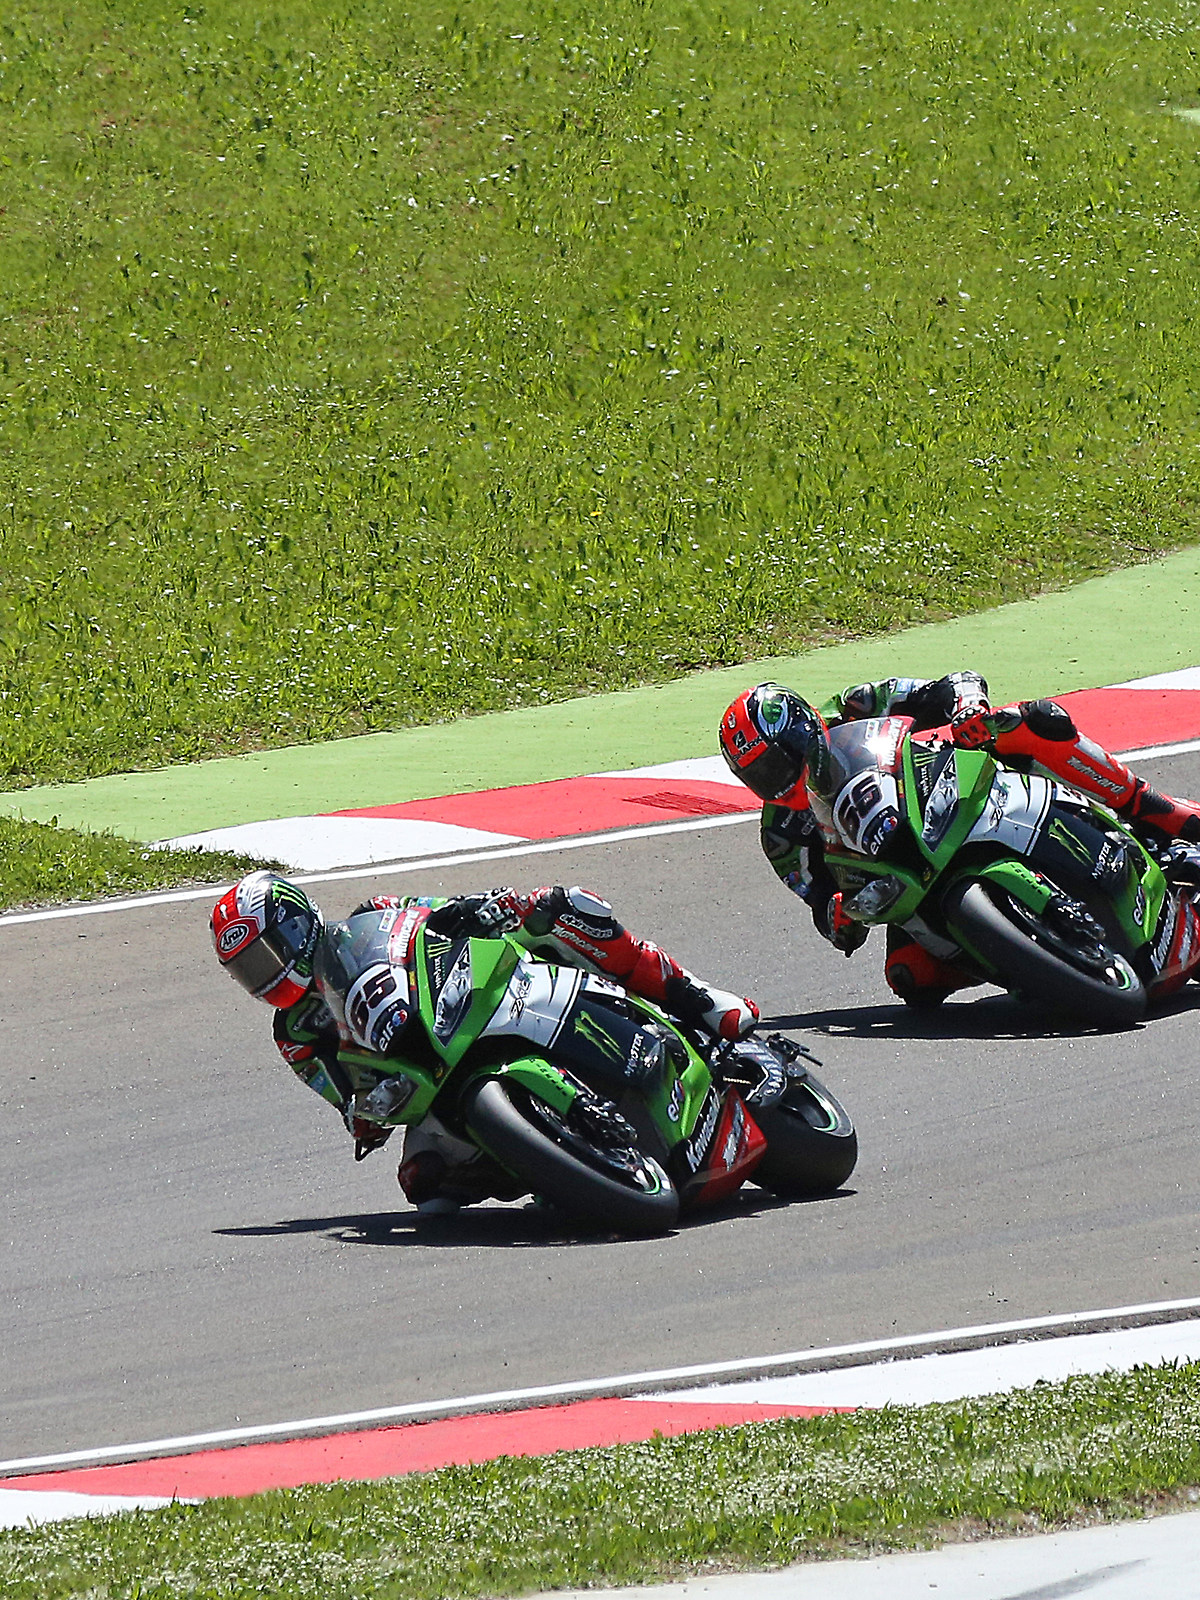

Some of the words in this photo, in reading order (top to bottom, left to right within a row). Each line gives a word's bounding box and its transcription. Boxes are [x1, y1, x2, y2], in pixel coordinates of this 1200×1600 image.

[1066, 756, 1127, 795] Motocard
[838, 773, 882, 846] 66
[869, 827, 885, 855] elf
[222, 926, 243, 947] Arai
[552, 924, 608, 959] Motocard
[350, 968, 397, 1040] 65
[378, 1022, 394, 1052] elf
[624, 1033, 644, 1077] MONSTER
